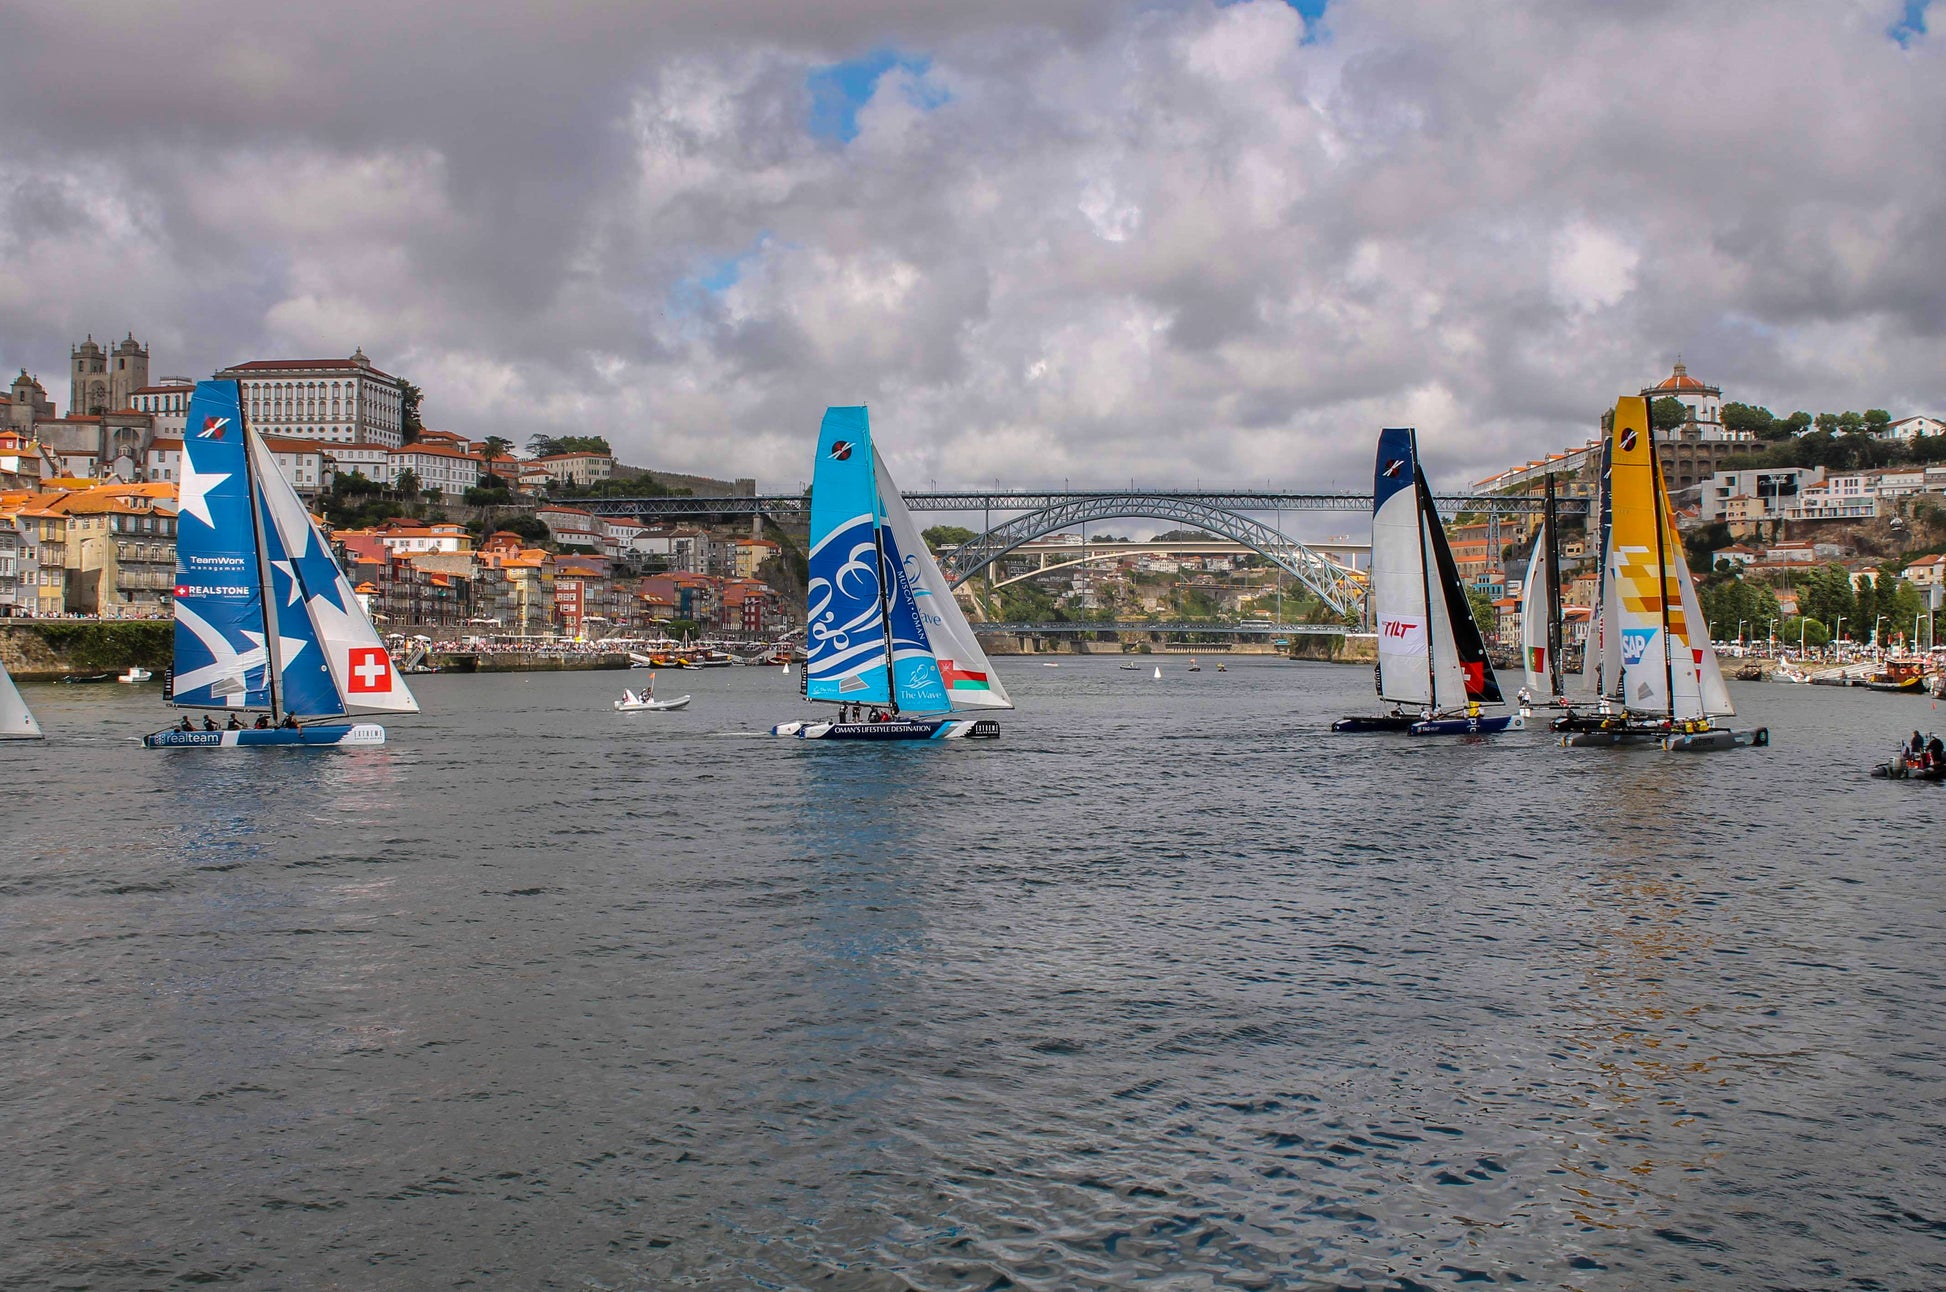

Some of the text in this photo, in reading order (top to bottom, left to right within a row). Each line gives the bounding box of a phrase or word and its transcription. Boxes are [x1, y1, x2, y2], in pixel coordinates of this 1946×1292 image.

[188, 586, 250, 595] REALSTONE
[897, 571, 926, 640] MUSCAT OMAN
[919, 608, 942, 626] ave
[1382, 620, 1418, 640] TILT
[1622, 635, 1646, 659] SAP
[901, 690, 942, 699] The Wave
[834, 726, 861, 734] OMAN'S
[862, 725, 890, 733] LIFESTYLE
[166, 733, 219, 743] realteam
